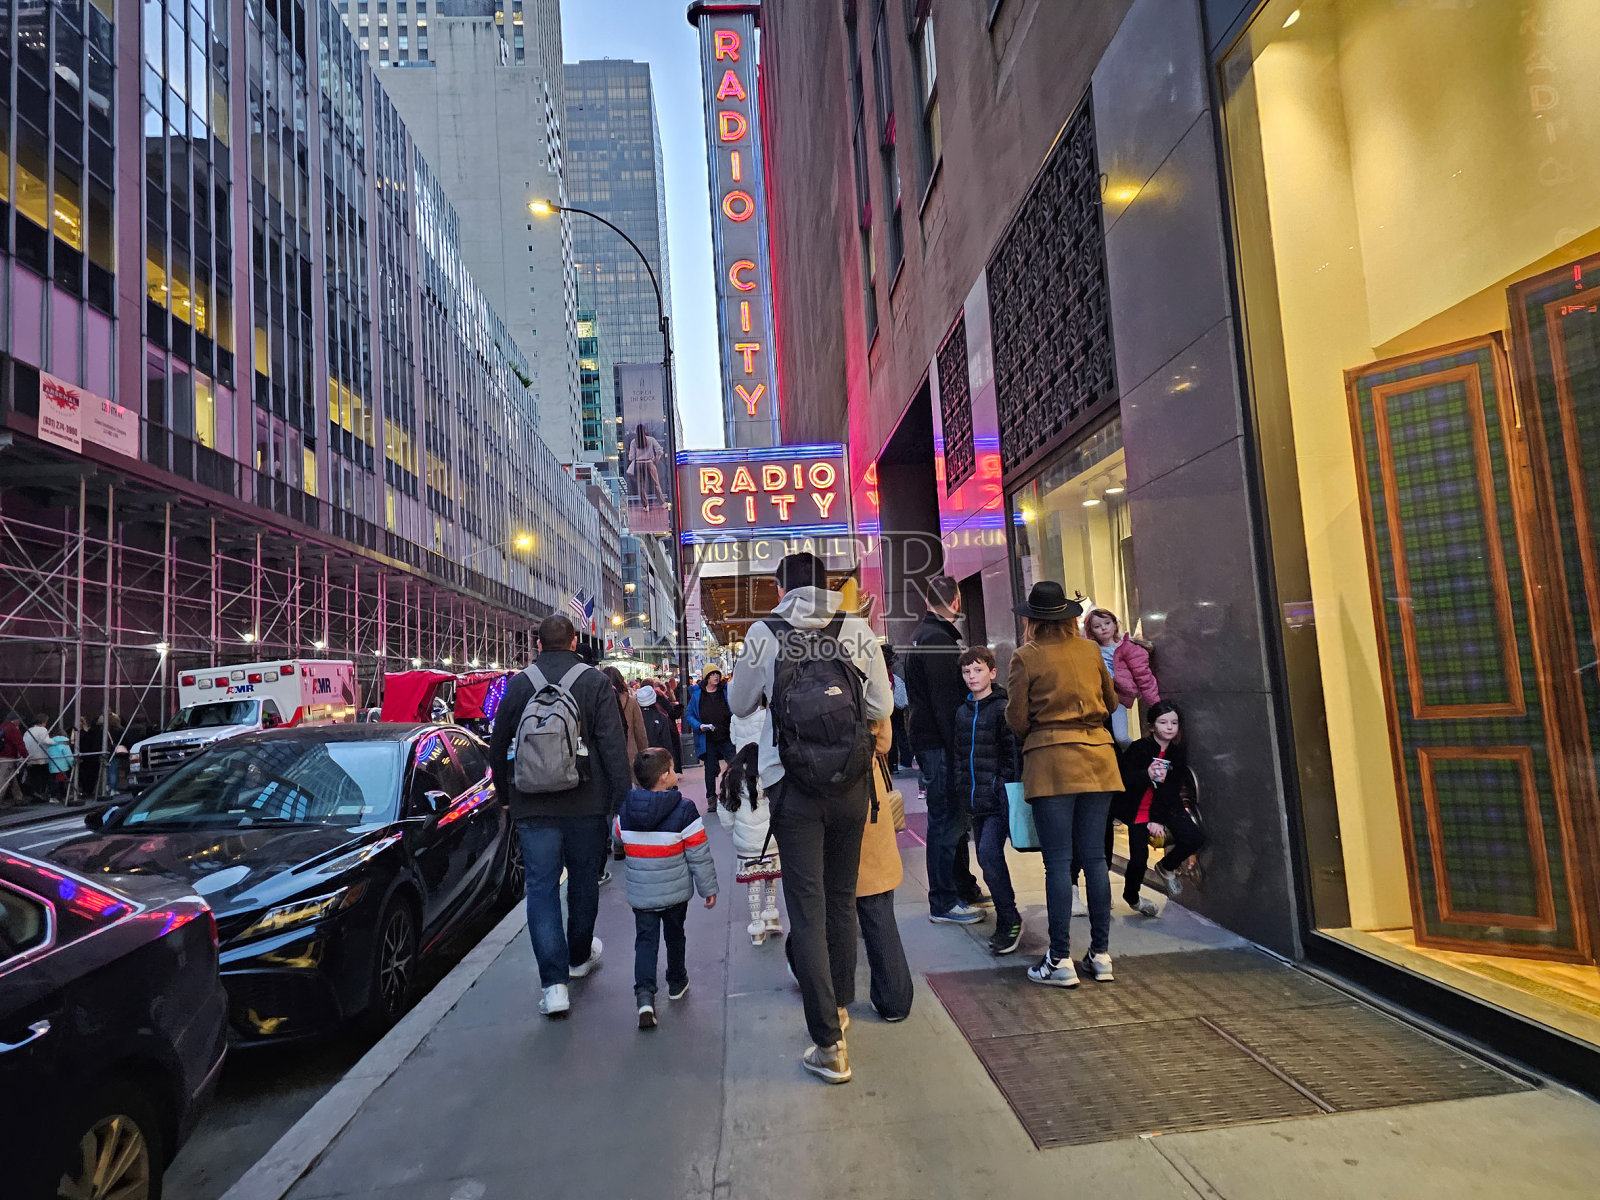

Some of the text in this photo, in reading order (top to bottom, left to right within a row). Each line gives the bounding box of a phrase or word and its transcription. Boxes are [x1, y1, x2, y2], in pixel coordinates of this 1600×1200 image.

[714, 30, 755, 222] RADIO
[729, 260, 767, 416] CITY
[44, 386, 78, 406] ARSENAL
[699, 462, 836, 495] RADIO
[701, 492, 837, 525] CITY
[694, 540, 770, 563] MUSIC
[784, 537, 847, 557] HALL
[226, 684, 255, 695] AMR
[312, 677, 331, 695] AMR
